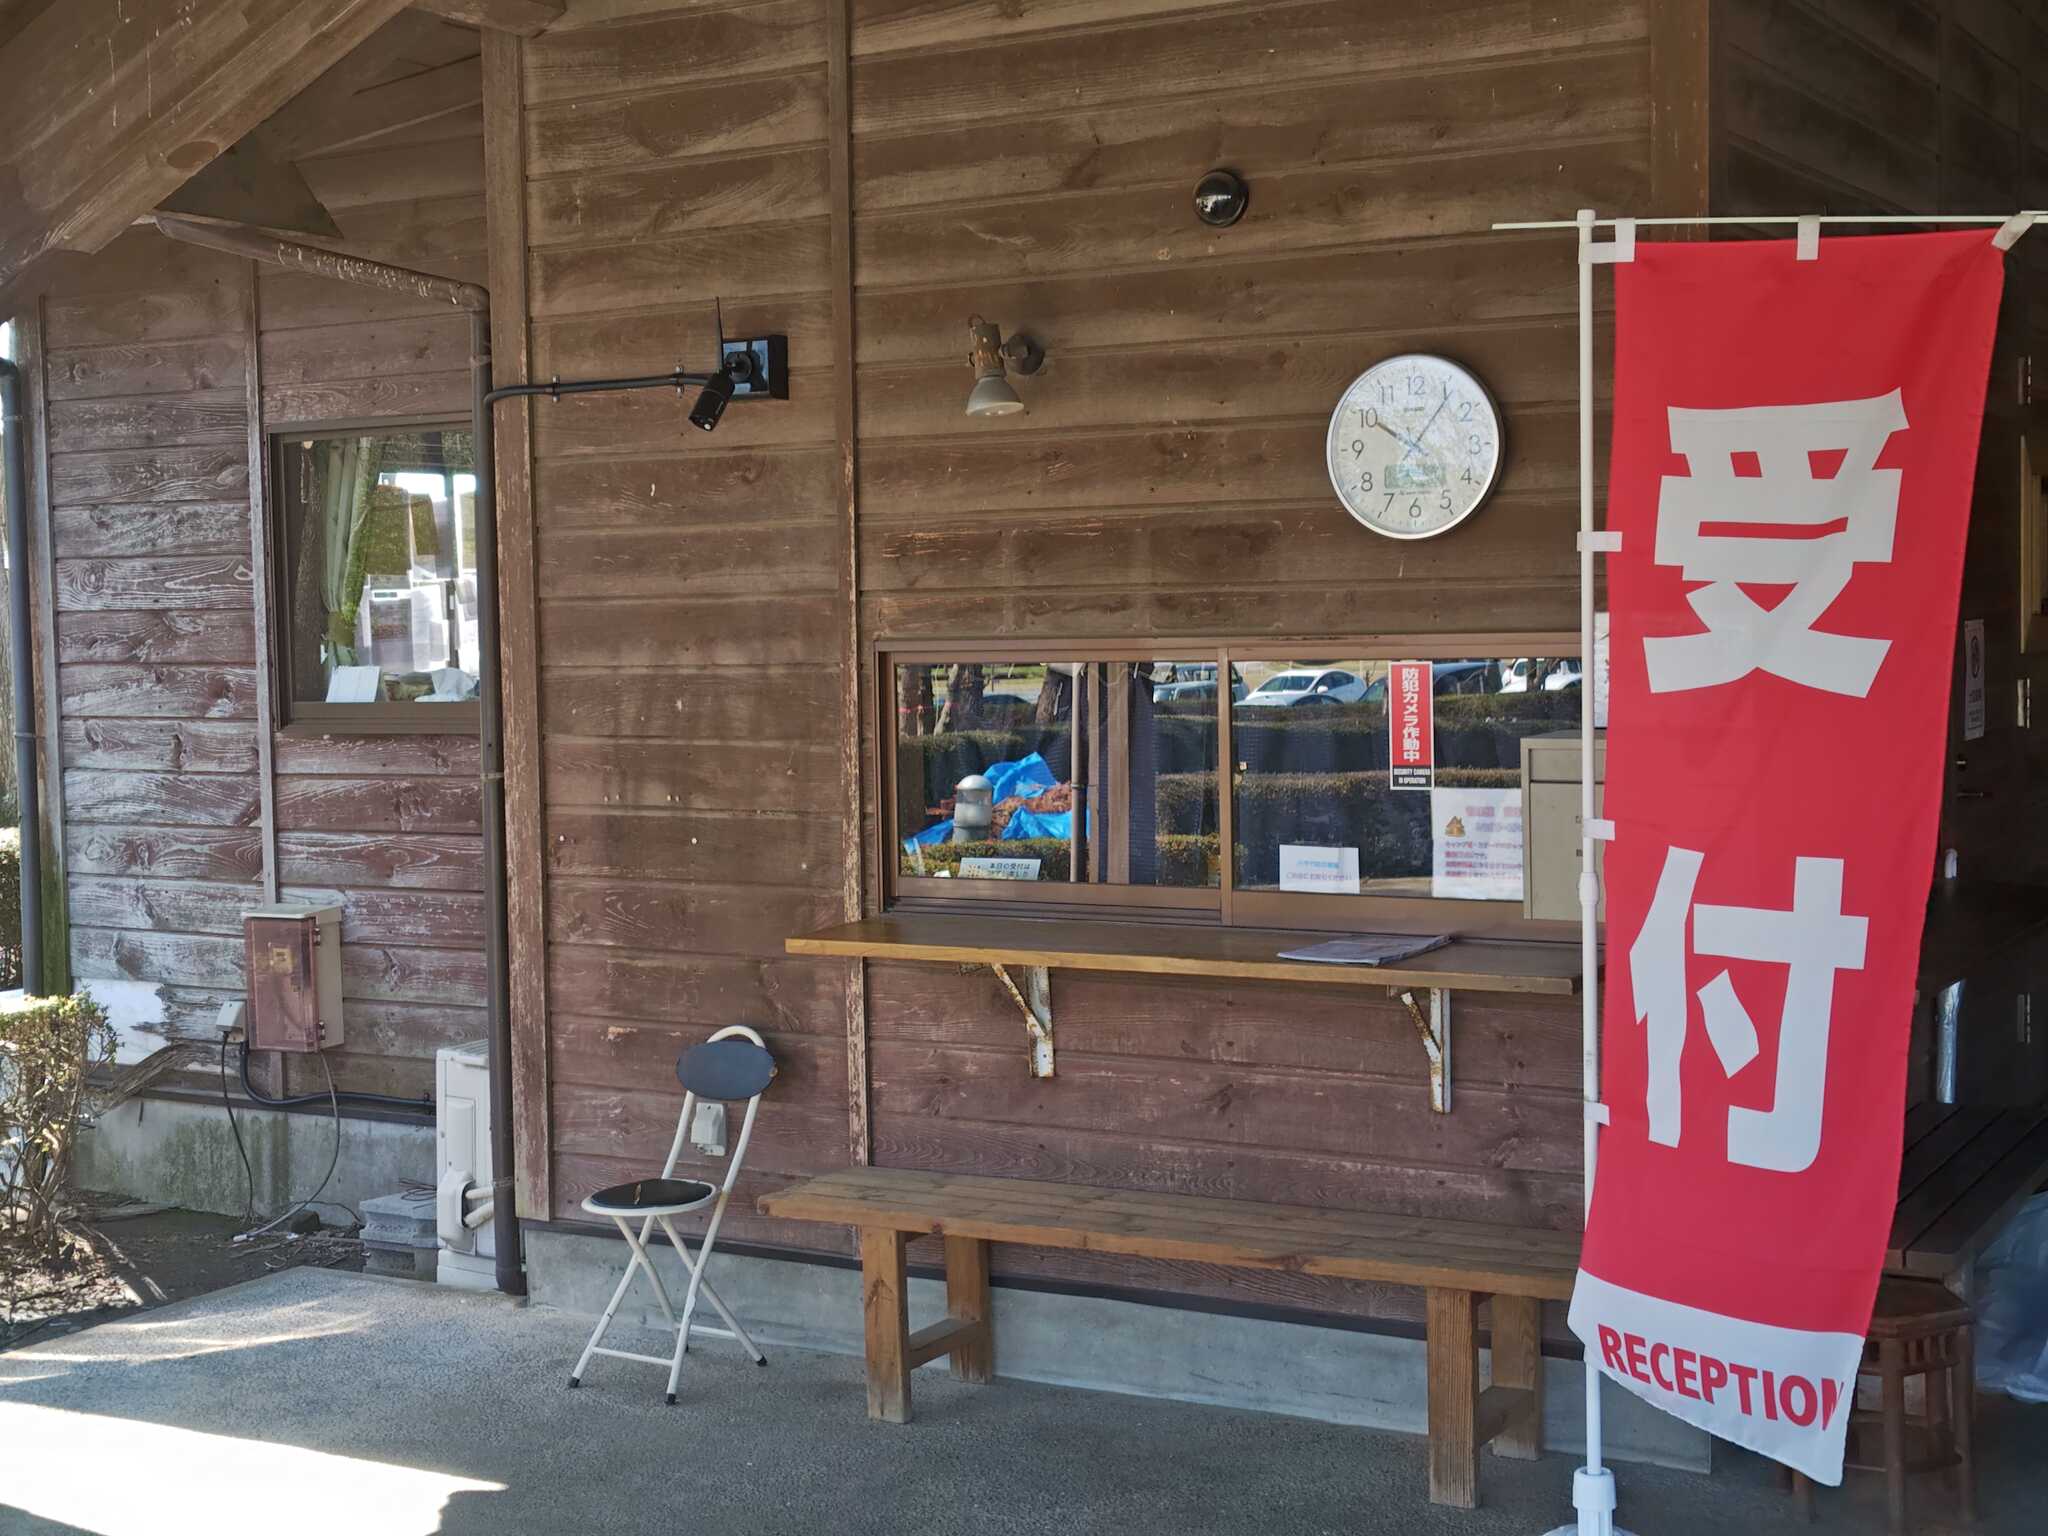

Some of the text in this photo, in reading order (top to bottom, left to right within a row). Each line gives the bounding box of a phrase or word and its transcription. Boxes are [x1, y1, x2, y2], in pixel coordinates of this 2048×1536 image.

[1379, 385, 1394, 404] 11
[1405, 376, 1425, 396] 12
[1358, 407, 1378, 428] 10
[1458, 402, 1473, 423] 2
[1351, 440, 1365, 460] 9
[1468, 435, 1482, 456] 3
[1360, 472, 1374, 492] 8
[1460, 468, 1472, 485] 4
[1383, 493, 1395, 513] 7
[1408, 497, 1422, 518] 6
[1439, 489, 1452, 509] 5
[1402, 667, 1420, 763] 防犯カメラ作動中
[1629, 387, 1910, 1173] 受付
